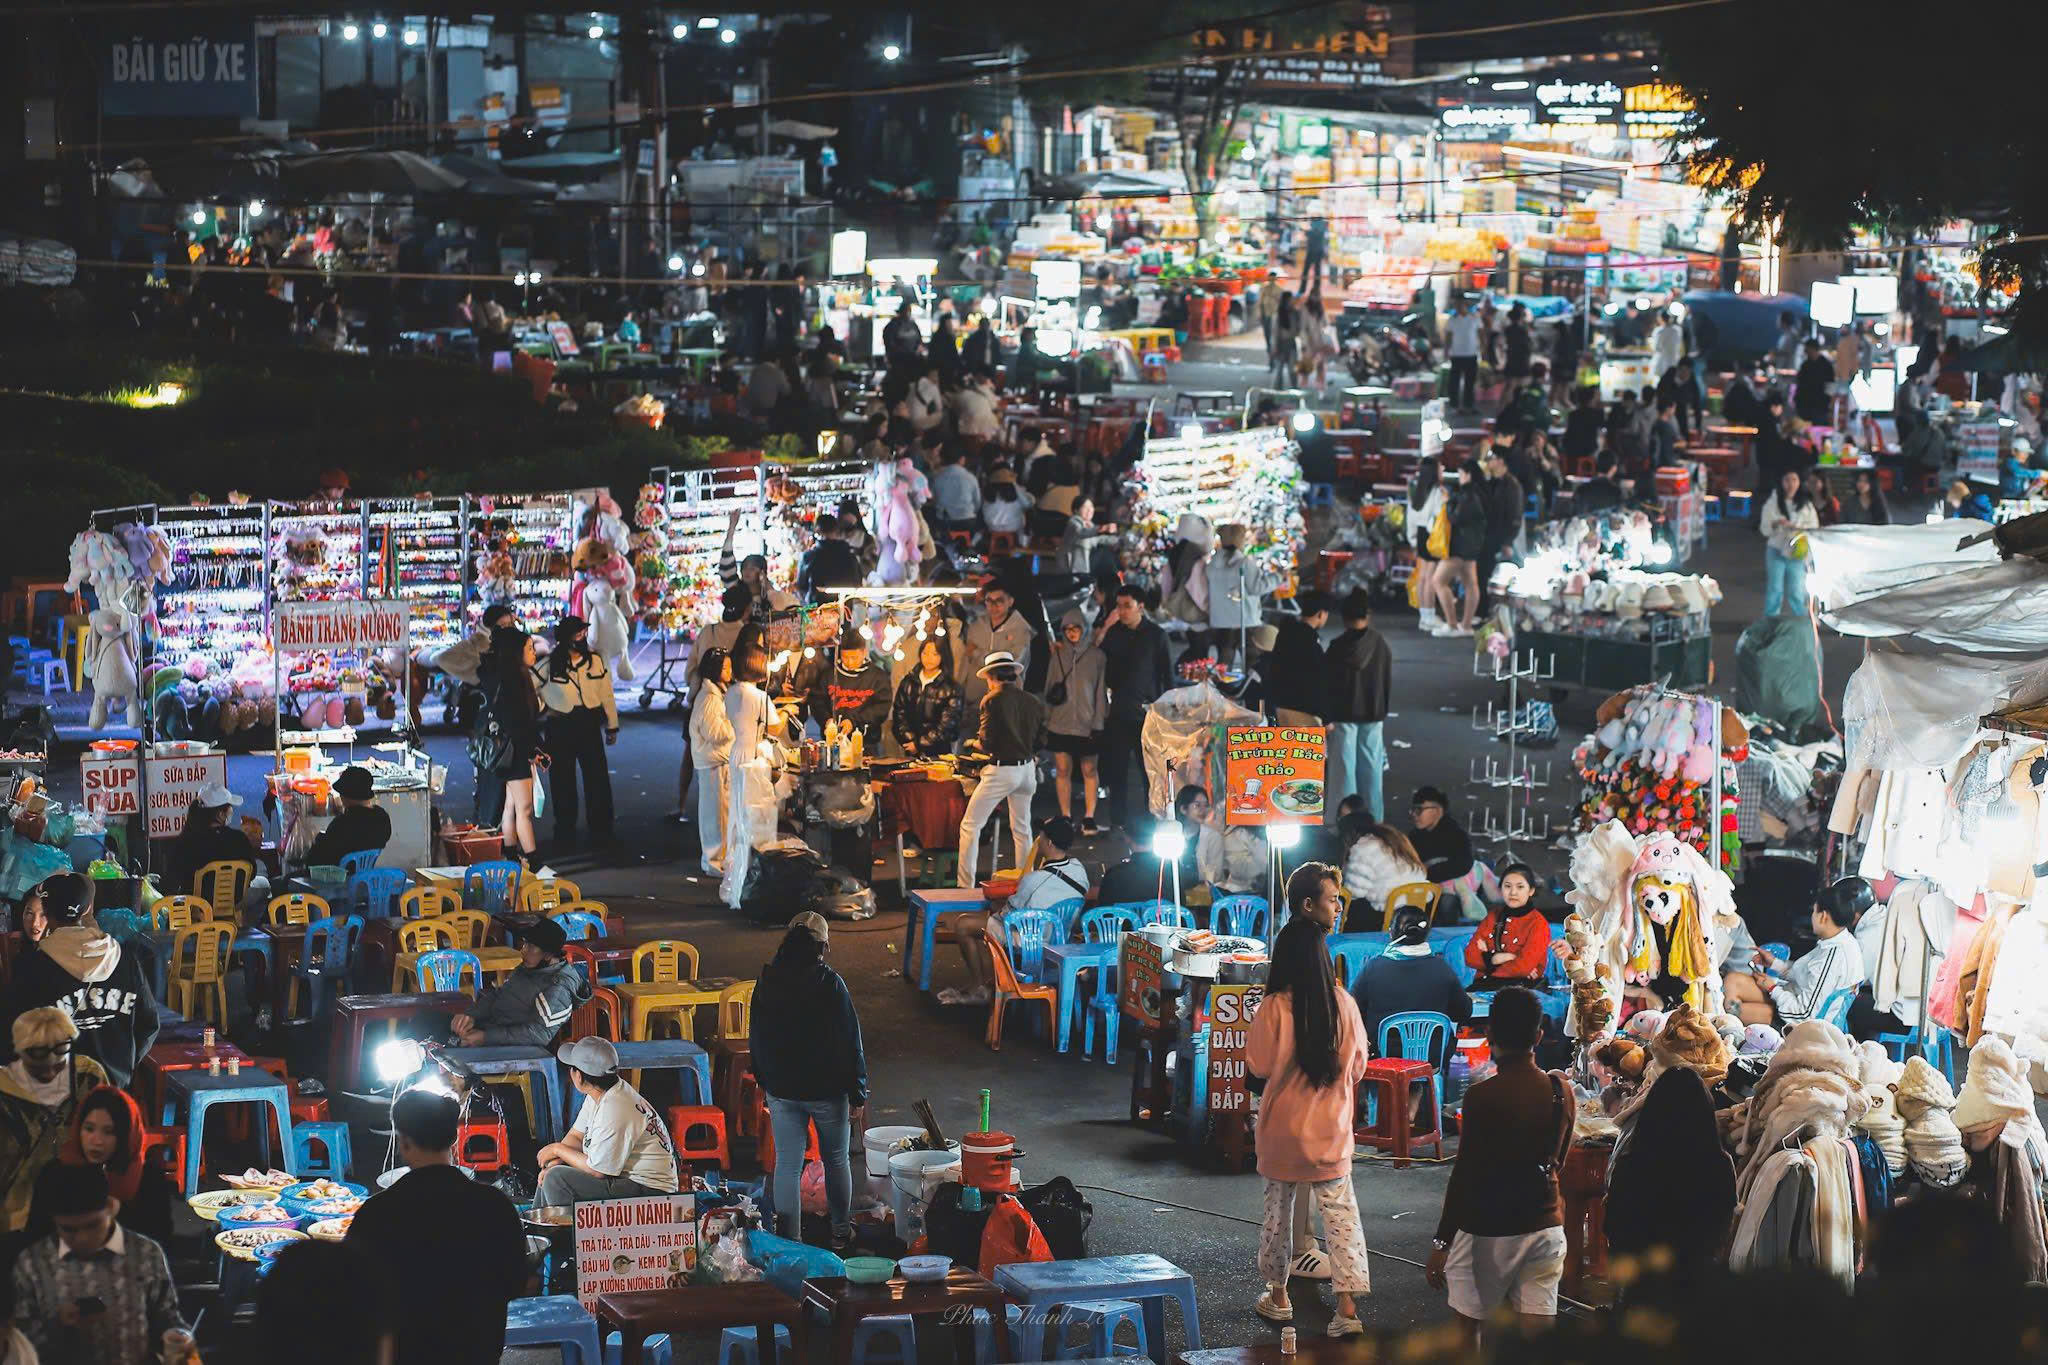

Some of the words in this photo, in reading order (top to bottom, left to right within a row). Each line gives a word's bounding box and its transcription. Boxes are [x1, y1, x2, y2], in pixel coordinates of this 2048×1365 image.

[214, 42, 246, 81] XE
[1230, 729, 1275, 744] Súp
[1280, 729, 1324, 744] Cua
[85, 764, 136, 789] SÚP
[163, 765, 184, 783] SỮA
[1212, 1027, 1248, 1053] ĐẬU
[1212, 1057, 1246, 1082] ĐẬU
[1211, 1085, 1245, 1110] BẮP
[576, 1203, 603, 1229] SỮA
[606, 1200, 633, 1232] ĐẬU
[636, 1199, 673, 1225] NÀNH
[638, 1256, 655, 1269] KEM
